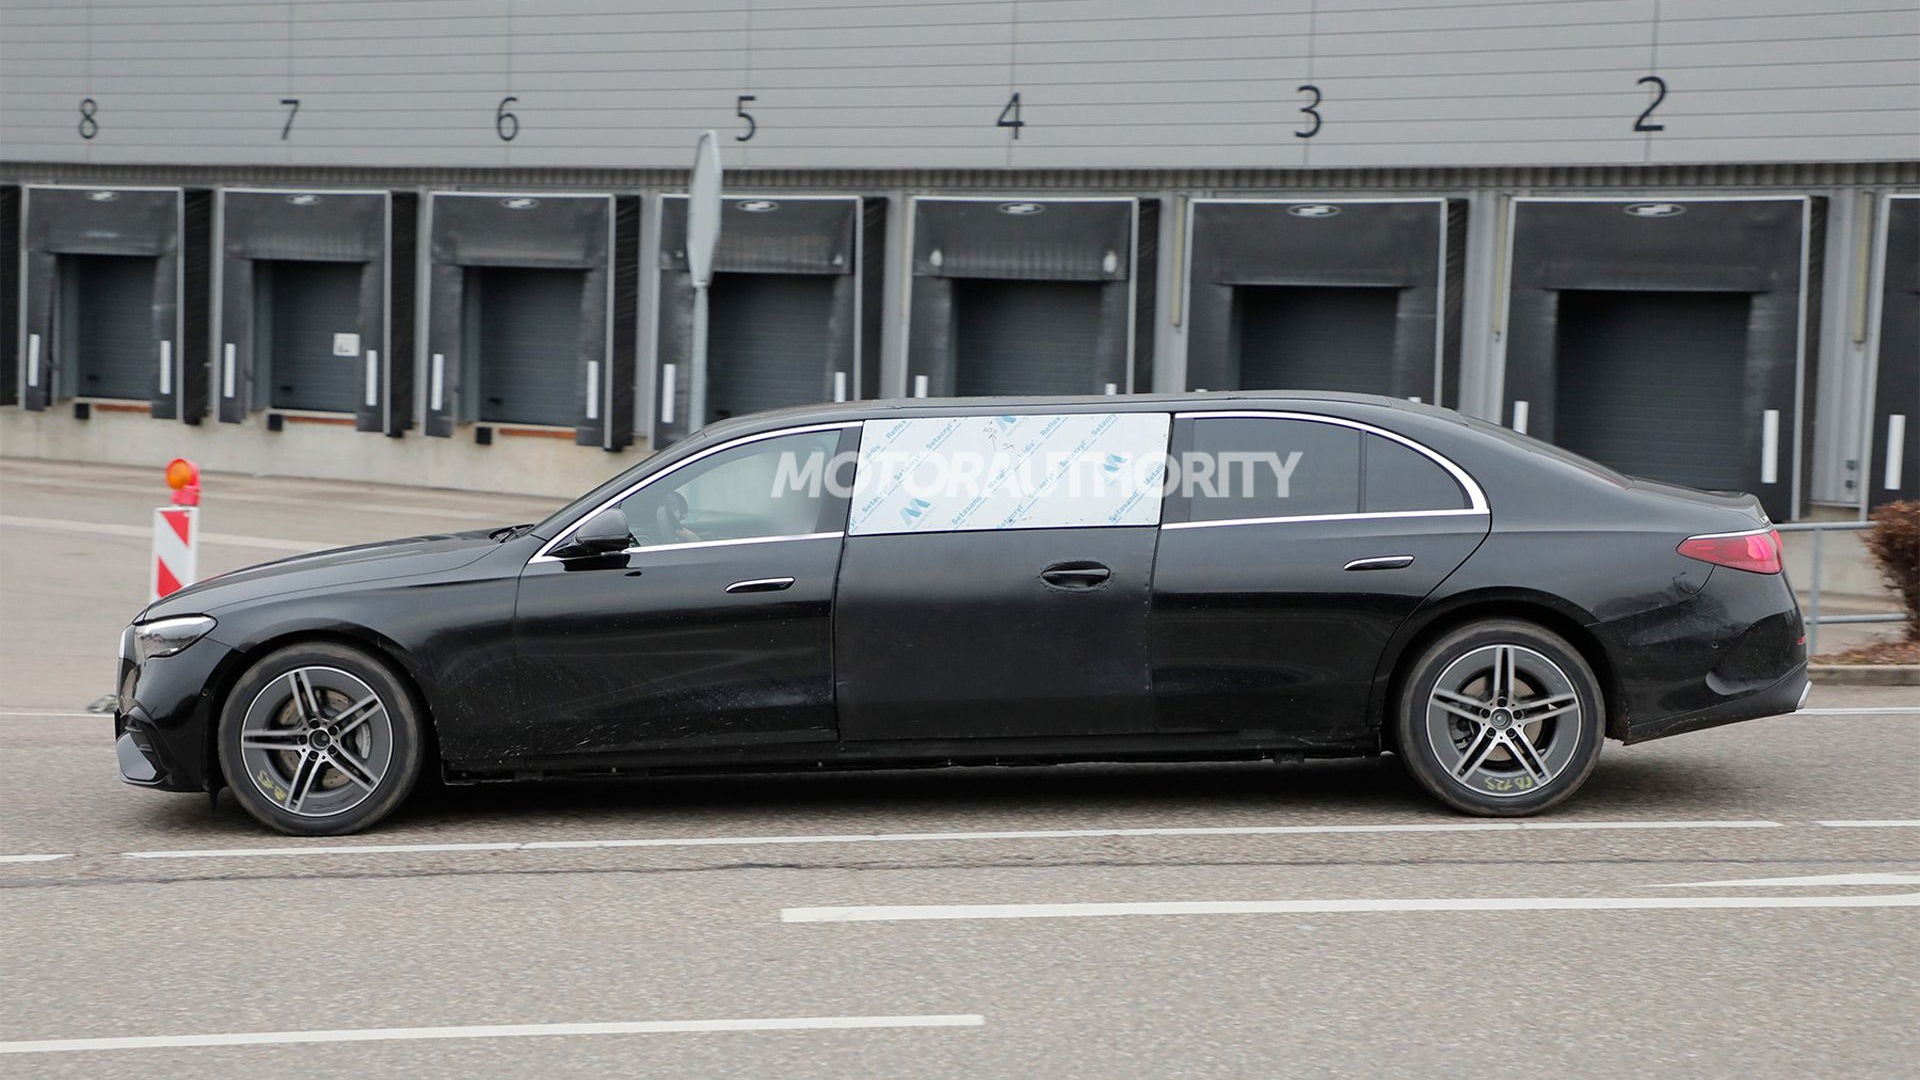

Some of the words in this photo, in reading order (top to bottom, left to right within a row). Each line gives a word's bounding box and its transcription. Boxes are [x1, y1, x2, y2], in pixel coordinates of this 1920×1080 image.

[78, 98, 99, 140] 8
[279, 99, 299, 140] 7
[494, 96, 519, 142] 6
[734, 95, 757, 142] 5
[994, 92, 1025, 140] 4
[1293, 85, 1322, 139] 3
[1631, 75, 1668, 132] 2
[1091, 413, 1117, 436] Setacry
